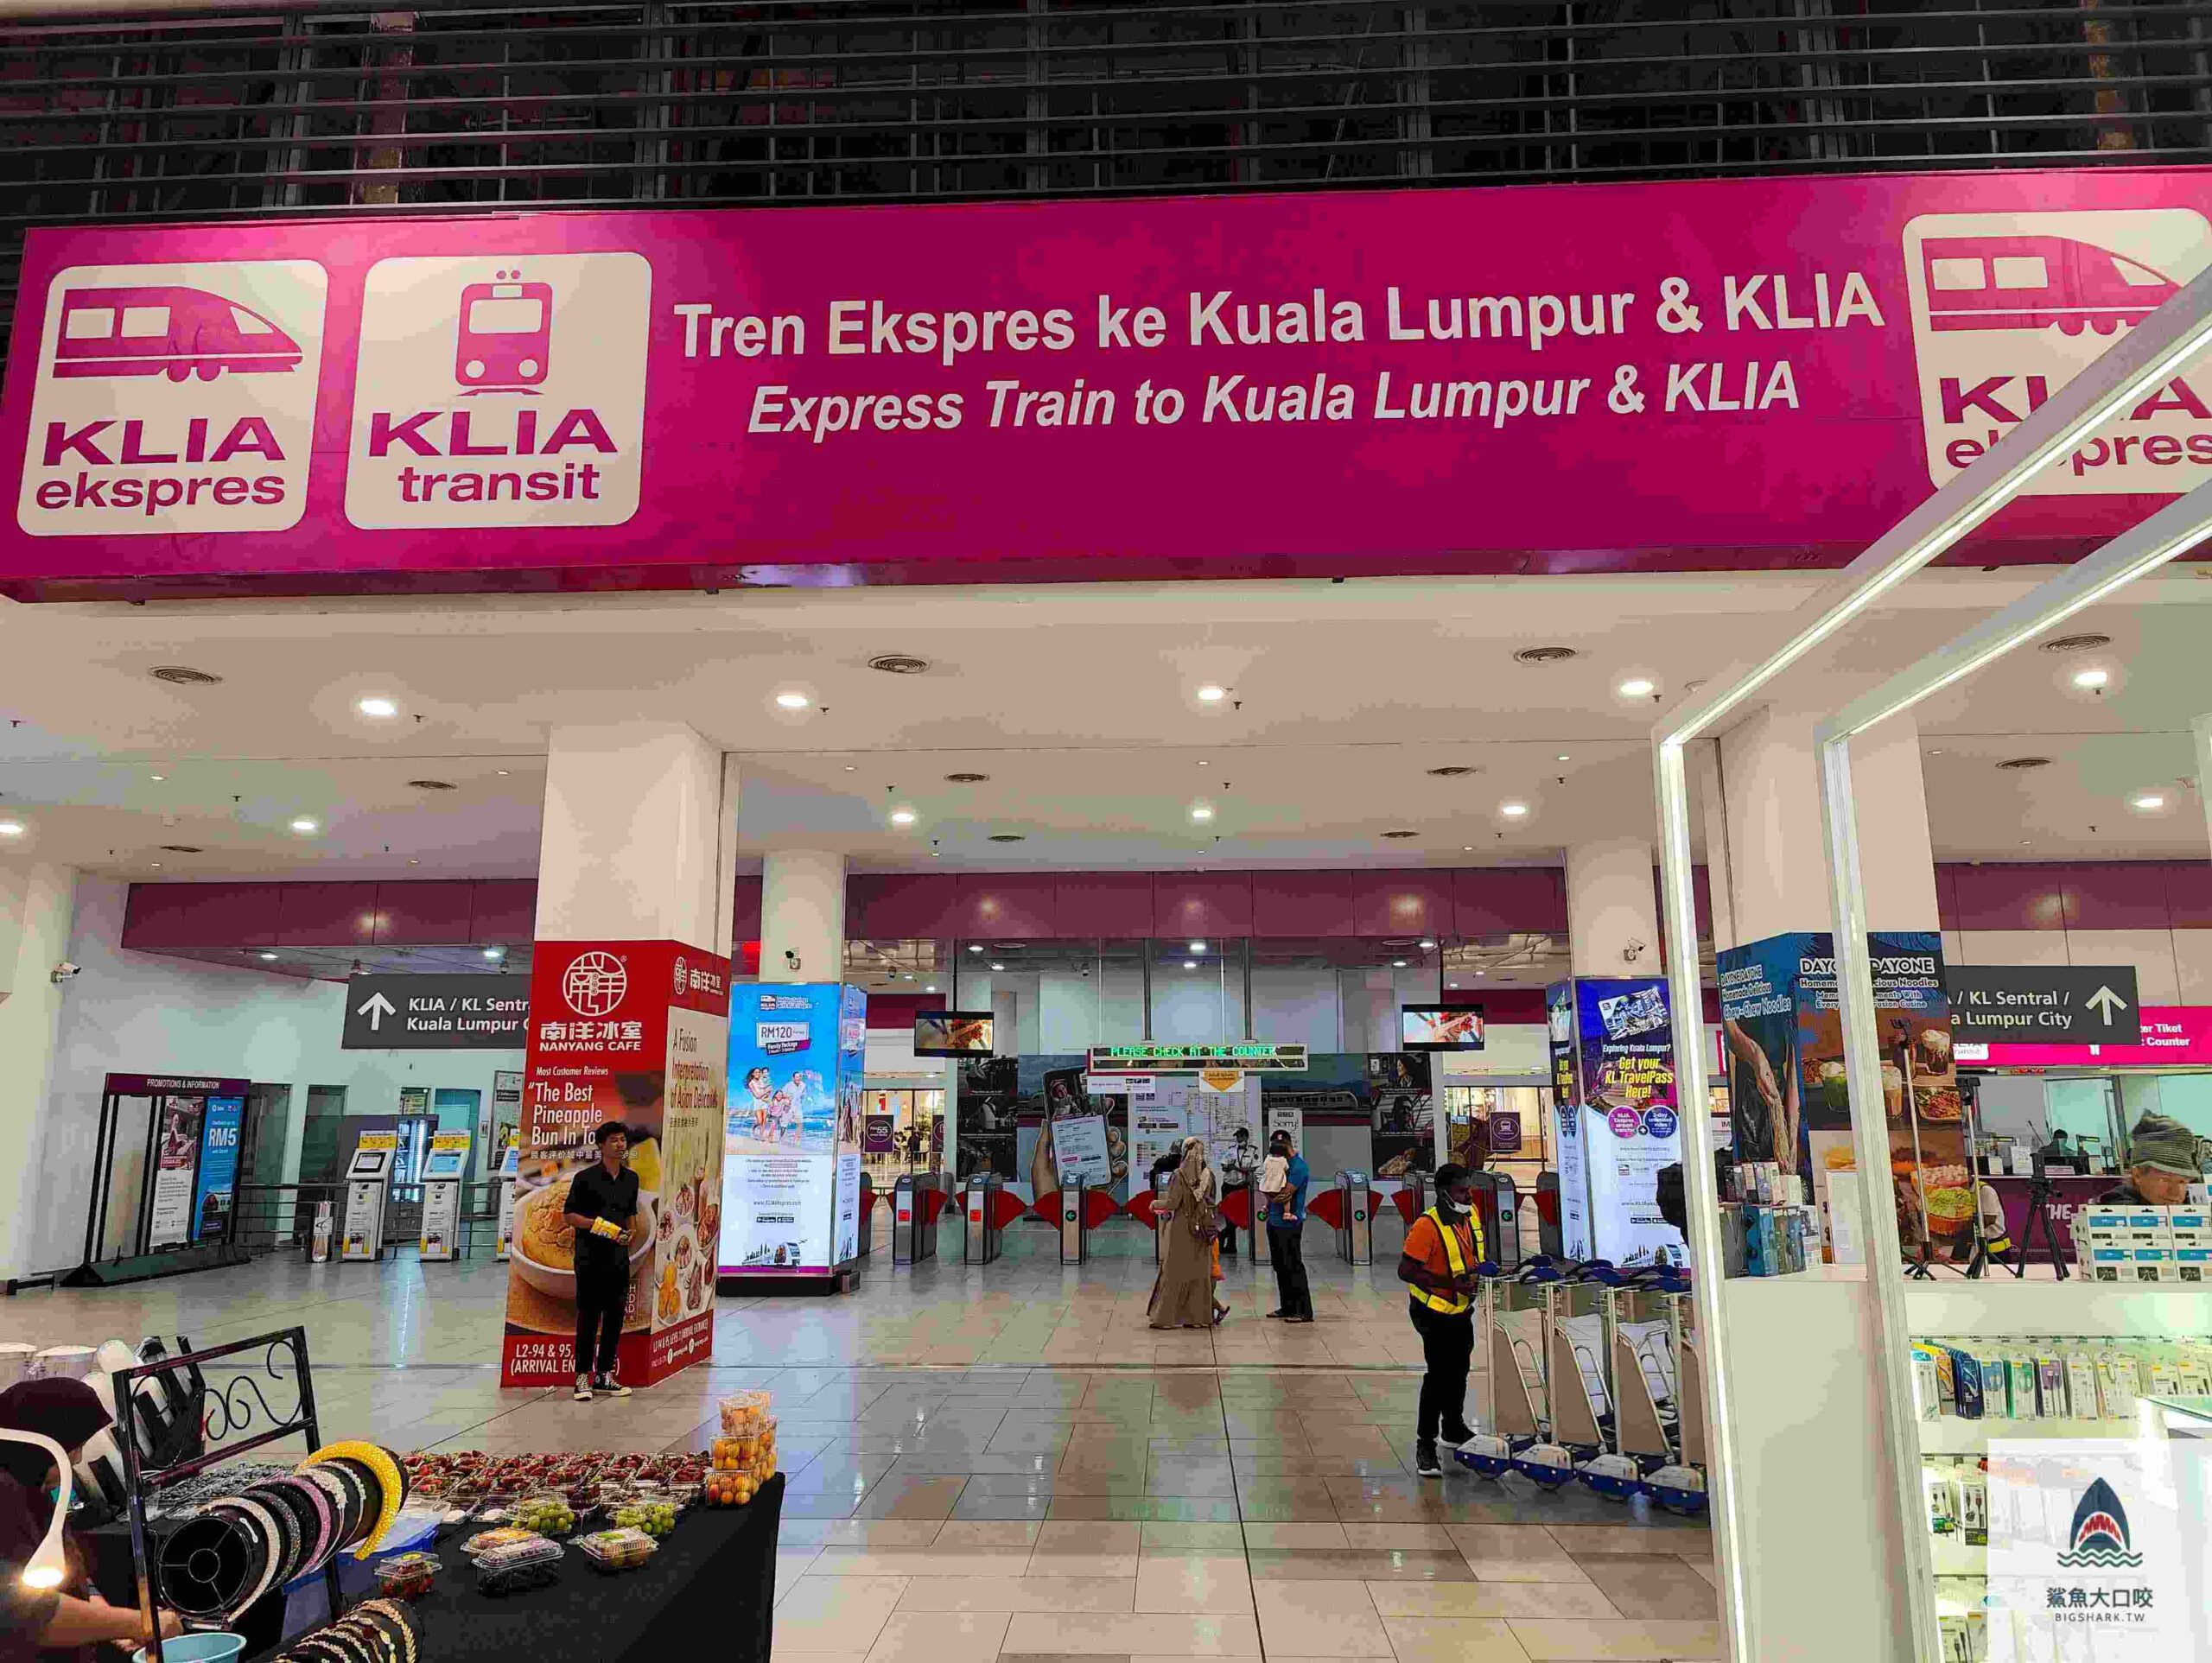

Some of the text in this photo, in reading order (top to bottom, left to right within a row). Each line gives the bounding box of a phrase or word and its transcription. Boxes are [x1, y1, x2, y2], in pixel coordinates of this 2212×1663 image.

[673, 271, 1885, 365] Tren Ekspres ke Kuala Lumpur & KLIA
[747, 359, 1801, 443] Express Train to Kuala Lumpur & KLIA
[1940, 376, 2212, 423] KA
[368, 409, 618, 457] KLIA
[41, 416, 286, 467] KLIA
[1946, 429, 2212, 476] epres
[397, 462, 601, 502] transit
[35, 472, 286, 516] ekspres
[1801, 959, 1836, 974] DAY
[1899, 978, 1938, 987] Noodles
[1904, 990, 1923, 999] With
[1956, 991, 1963, 1005] /
[1969, 991, 1991, 1005] KL
[1996, 991, 2058, 1006] Sentral
[2063, 992, 2070, 1006] /
[409, 997, 529, 1011] KLIA / KL Sentr
[1762, 994, 1791, 1015] Noodles
[407, 1017, 452, 1031] Kuala
[457, 1018, 518, 1034] Lumpur
[1966, 1012, 2033, 1029] Lumpur
[2038, 1011, 2072, 1029] City
[540, 1021, 642, 1041] 南洋冰室
[761, 1026, 792, 1038] RM120
[2154, 1024, 2183, 1033] Tiket
[539, 1041, 641, 1051] NANYANG CAFE
[673, 1028, 697, 1053] A Fusion
[2146, 1037, 2190, 1046] Counter
[1111, 1045, 1277, 1057] PLEASE CHECK AT THE COUNTER
[1602, 1044, 1671, 1054] Exploring Kuala Lumpur?
[536, 1065, 609, 1076] Most Customer Reviews
[1618, 1057, 1661, 1071] Get your
[147, 1078, 220, 1089] PROMOTIONS & INFORMATION
[1605, 1071, 1674, 1084] KL TravelPass
[564, 1082, 594, 1102] Best
[1625, 1085, 1652, 1098] Here!
[533, 1103, 603, 1128] Pineapple
[208, 1127, 238, 1147] RM5
[531, 1126, 558, 1146] Bun
[563, 1126, 577, 1146] In
[516, 1344, 574, 1360] L2-94 & 95,
[511, 1360, 558, 1375] (ARRIVAL
